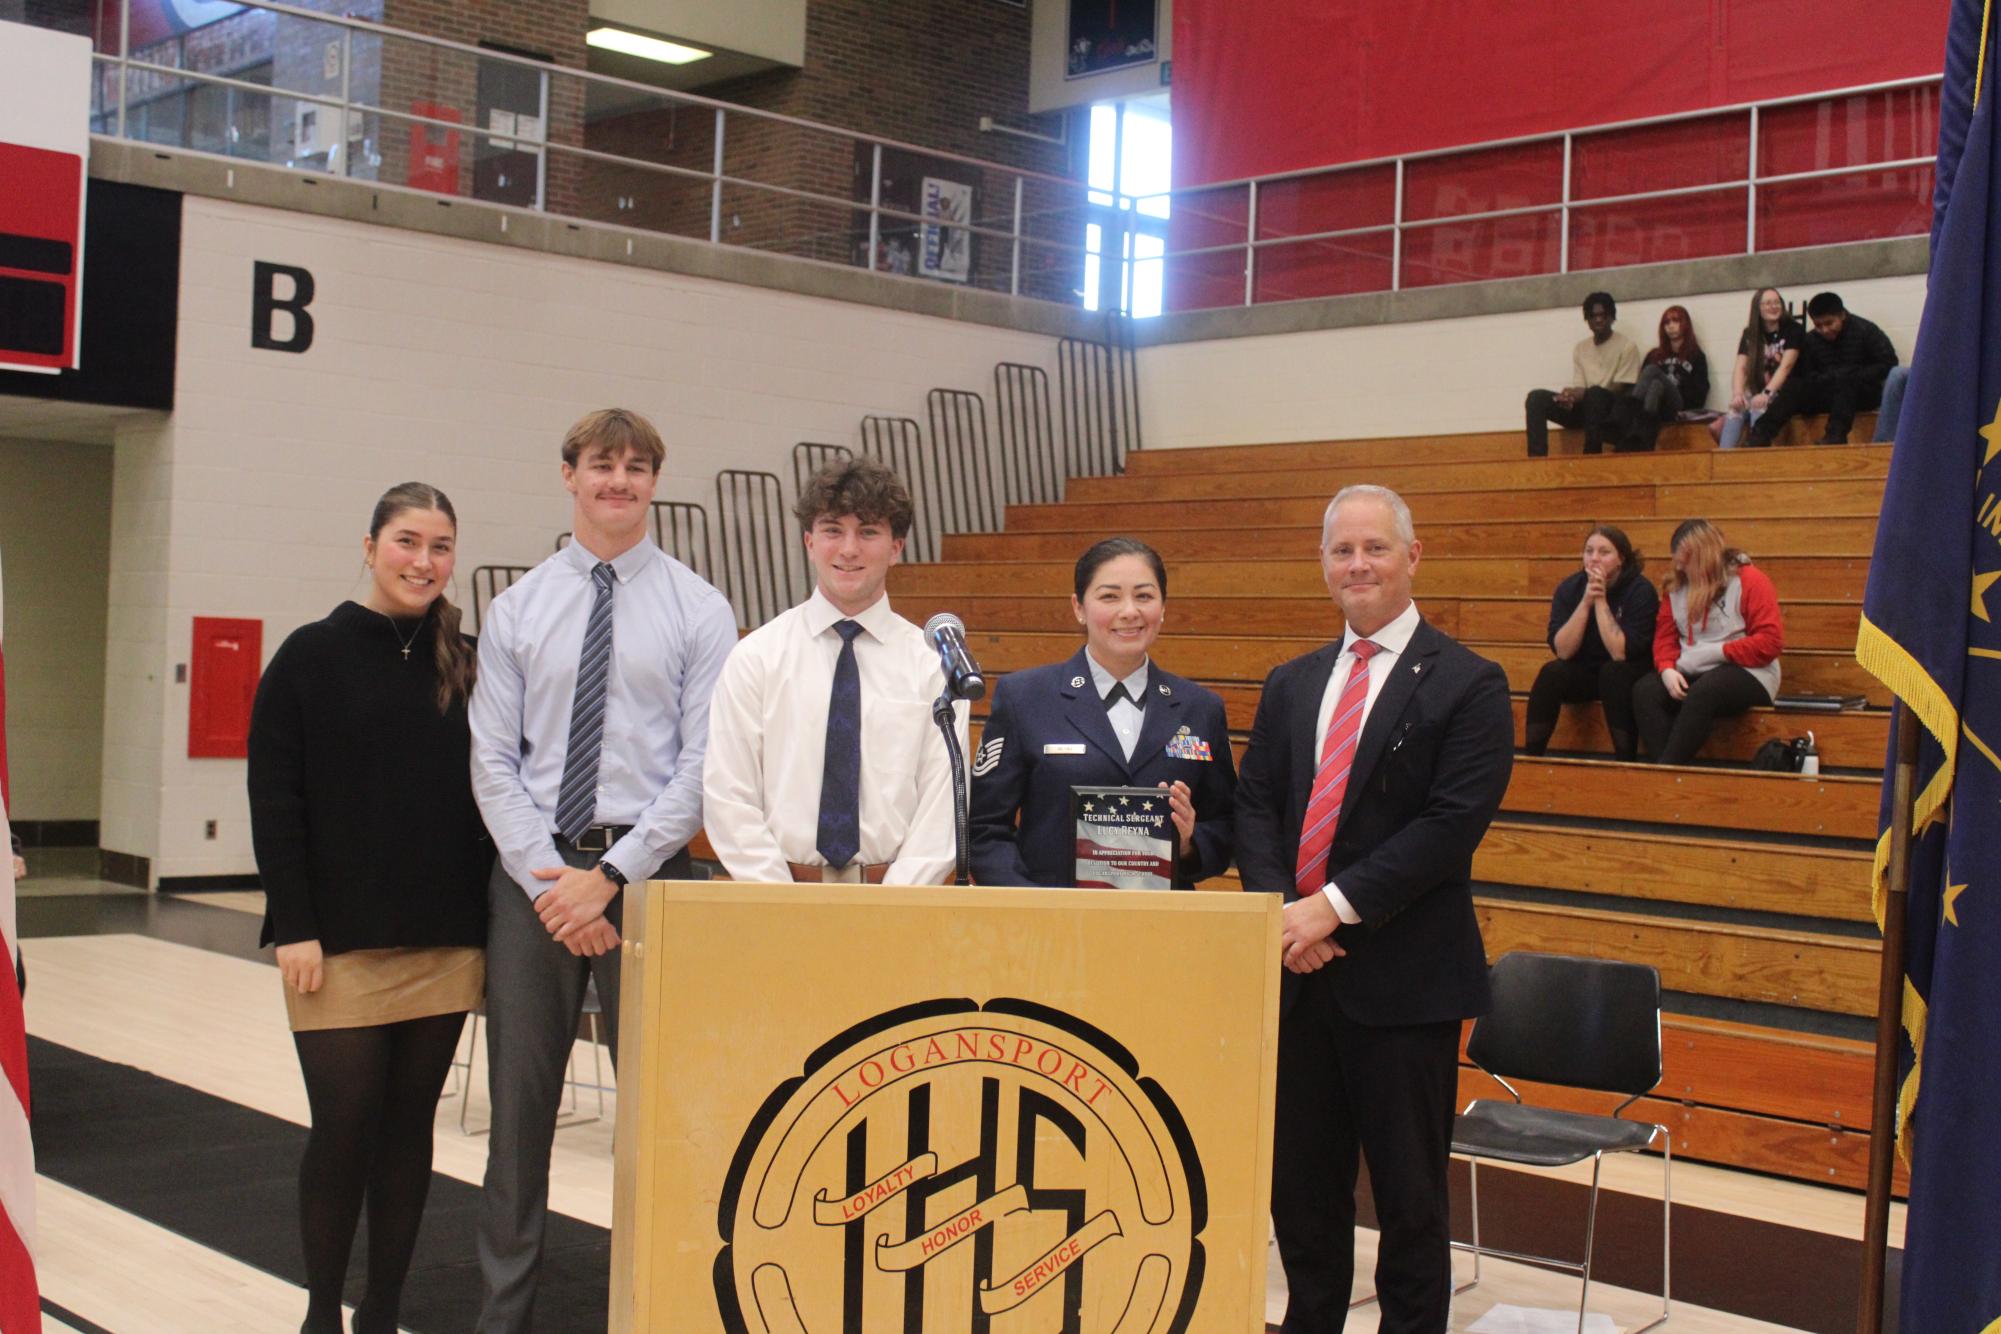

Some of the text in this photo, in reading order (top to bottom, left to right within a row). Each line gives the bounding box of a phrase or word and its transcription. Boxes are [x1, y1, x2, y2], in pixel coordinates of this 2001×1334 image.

[251, 260, 315, 354] B
[1083, 814, 1164, 822] TECHNICAL SERGEANT
[1121, 826, 1149, 835] REYNA
[831, 1032, 1113, 1108] LOGANSPORT
[841, 1165, 914, 1219] LOYALTY
[920, 1209, 982, 1255] HONOR
[1014, 1239, 1081, 1297] SERVICE
